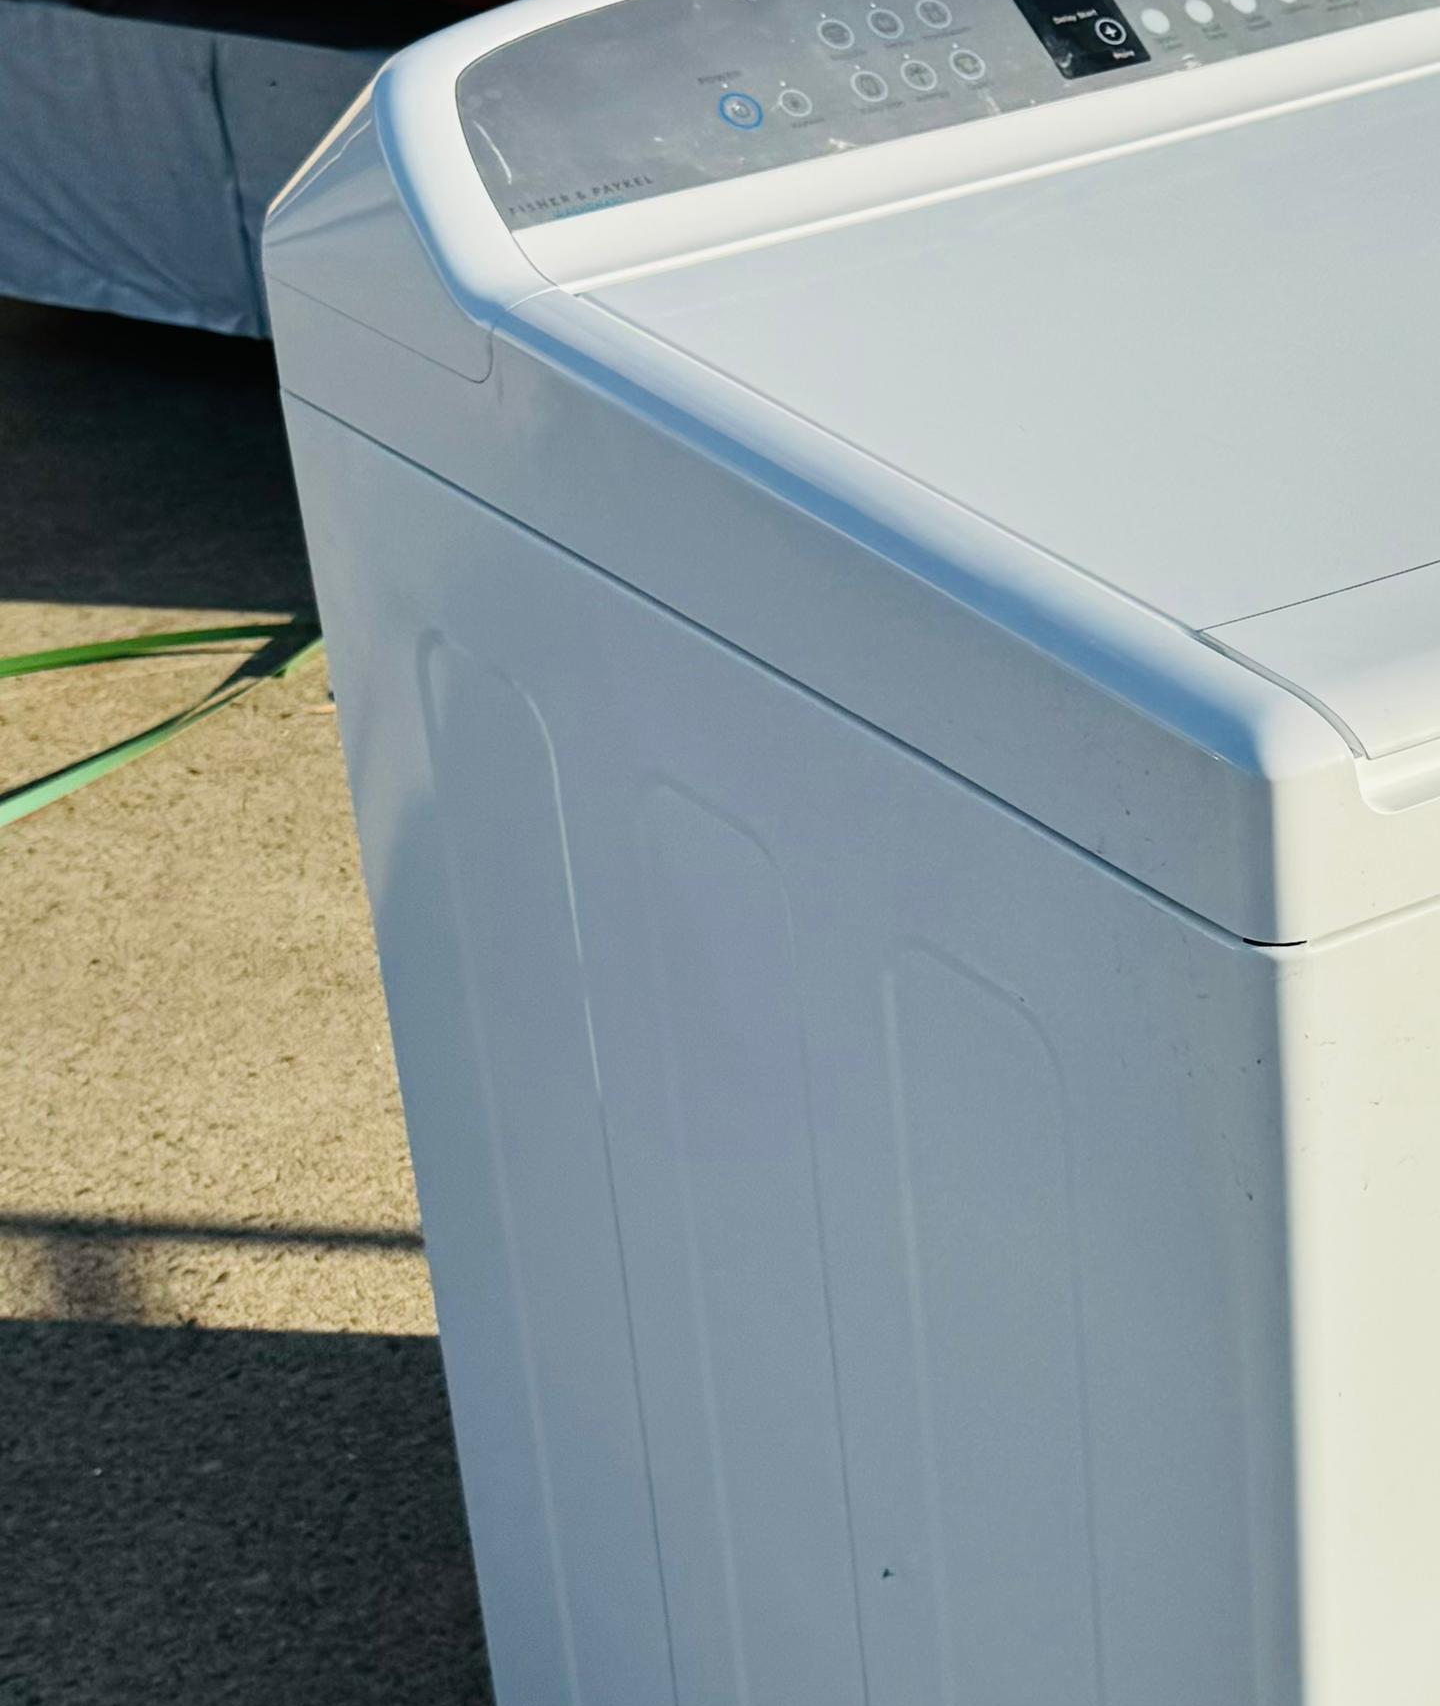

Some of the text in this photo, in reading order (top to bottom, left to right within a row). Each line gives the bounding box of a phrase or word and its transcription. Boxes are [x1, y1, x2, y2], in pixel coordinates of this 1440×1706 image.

[509, 195, 571, 215] FISHER
[575, 191, 586, 201] &
[591, 175, 654, 195] PAYKEL
